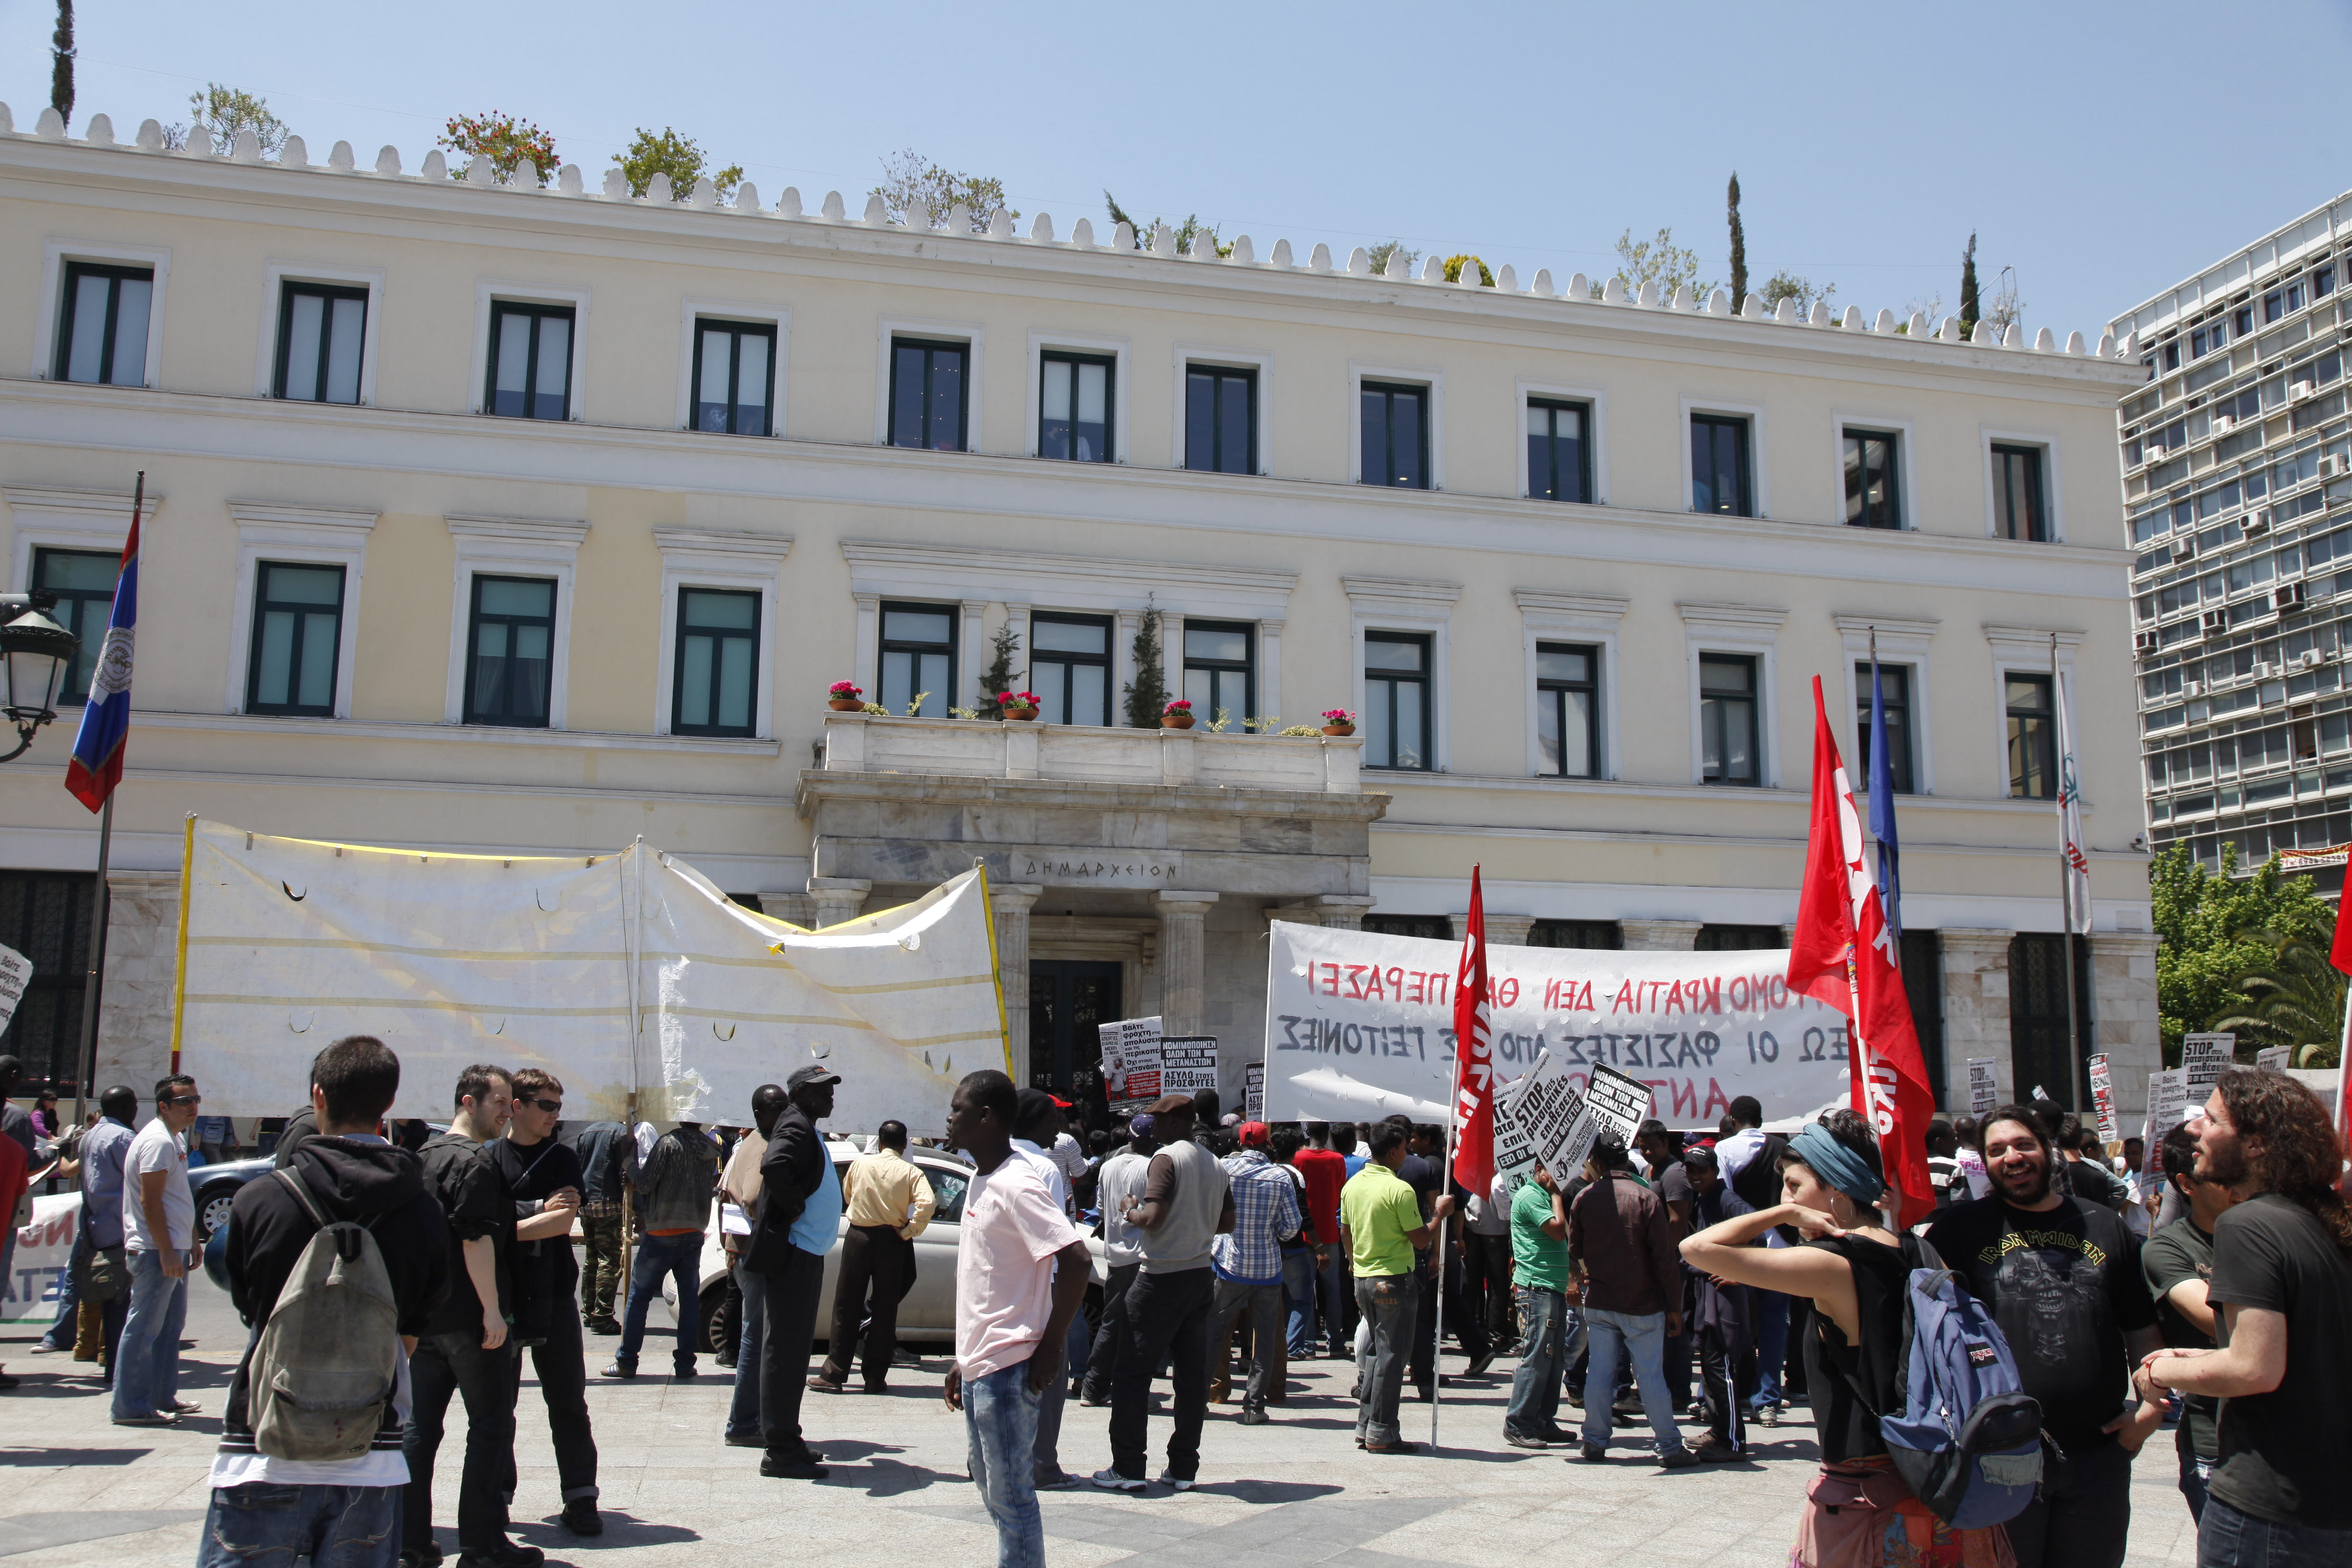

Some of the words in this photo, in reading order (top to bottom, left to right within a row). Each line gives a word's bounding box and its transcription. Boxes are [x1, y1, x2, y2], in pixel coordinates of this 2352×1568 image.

[1026, 861, 1176, 879] ΔΗΜΑΡΧΕΙΟΝ
[1122, 1023, 1144, 1031] Βάλτε
[1124, 1030, 1151, 1039] φράχτη
[1163, 1041, 1216, 1050] ΝΟΜΙΜΟΠΟΙΗΣΗ
[2185, 1042, 2214, 1056] STOP
[1125, 1047, 1160, 1058] περικοπέ
[1166, 1050, 1185, 1058] ΟΛΩΝ
[1188, 1049, 1201, 1057] ΤΩΝ
[1166, 1058, 1211, 1067] ΜΕΤΑΝΑΣΤΩΝ
[1127, 1063, 1160, 1074] μετανάστε
[1164, 1071, 1193, 1079] ΑΣΥΛΟ
[1249, 1075, 1262, 1084] ΟΛΩΝ
[2162, 1076, 2177, 1084] Βάλτε
[1164, 1079, 1216, 1087] ΠΡΟΣΦΥΓΕΣ
[1593, 1069, 1650, 1103] ΝΟΜΙΜΟΠΟΙΗΣΗ
[1593, 1080, 1615, 1098] ΟΛΩΝ
[1615, 1088, 1631, 1105] ΤΩΝ
[1249, 1095, 1263, 1103] ΑΣΥΛ
[1515, 1081, 1546, 1129] STOP
[1589, 1090, 1638, 1121] ΜΕΤΑΝΑΣΤΩΝ
[1614, 1121, 1632, 1136] ΣΤΟΥΣ
[1978, 1231, 2029, 1265] IRON
[2025, 1230, 2106, 1266] MAIDEN
